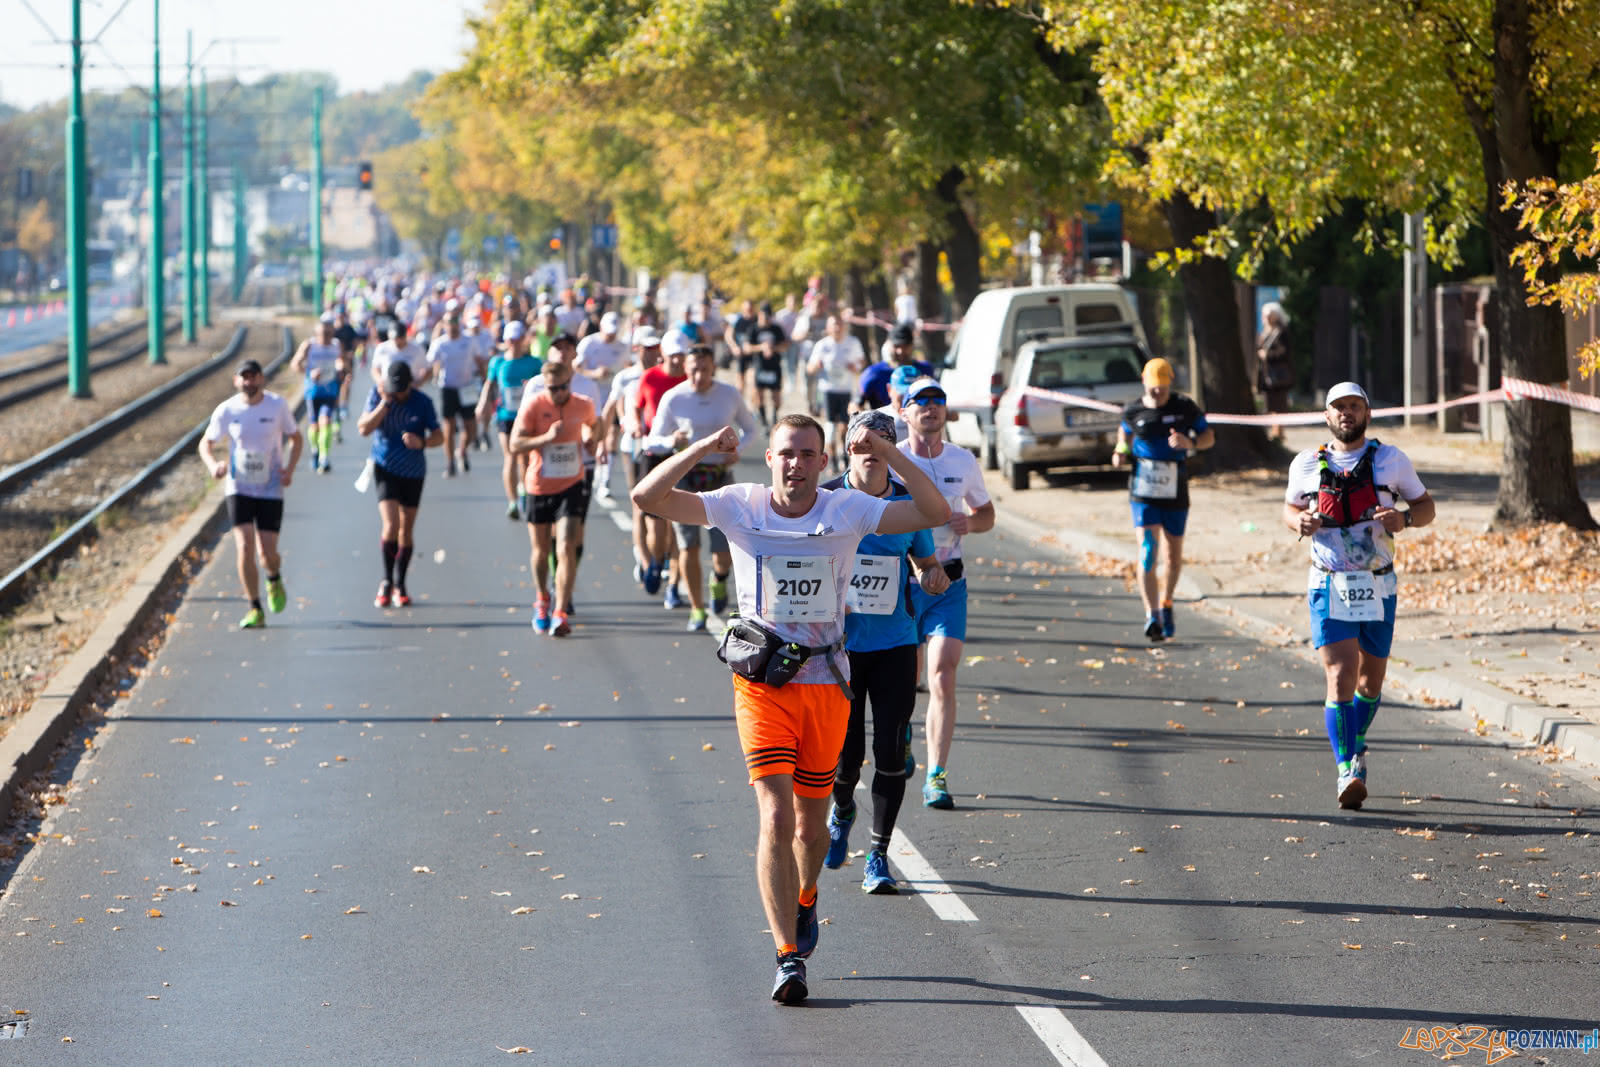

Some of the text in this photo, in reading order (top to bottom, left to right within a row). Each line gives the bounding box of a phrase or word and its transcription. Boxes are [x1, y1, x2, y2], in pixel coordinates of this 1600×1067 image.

[777, 579, 822, 596] 2107
[850, 574, 889, 591] 4977
[1340, 588, 1375, 601] 3822
